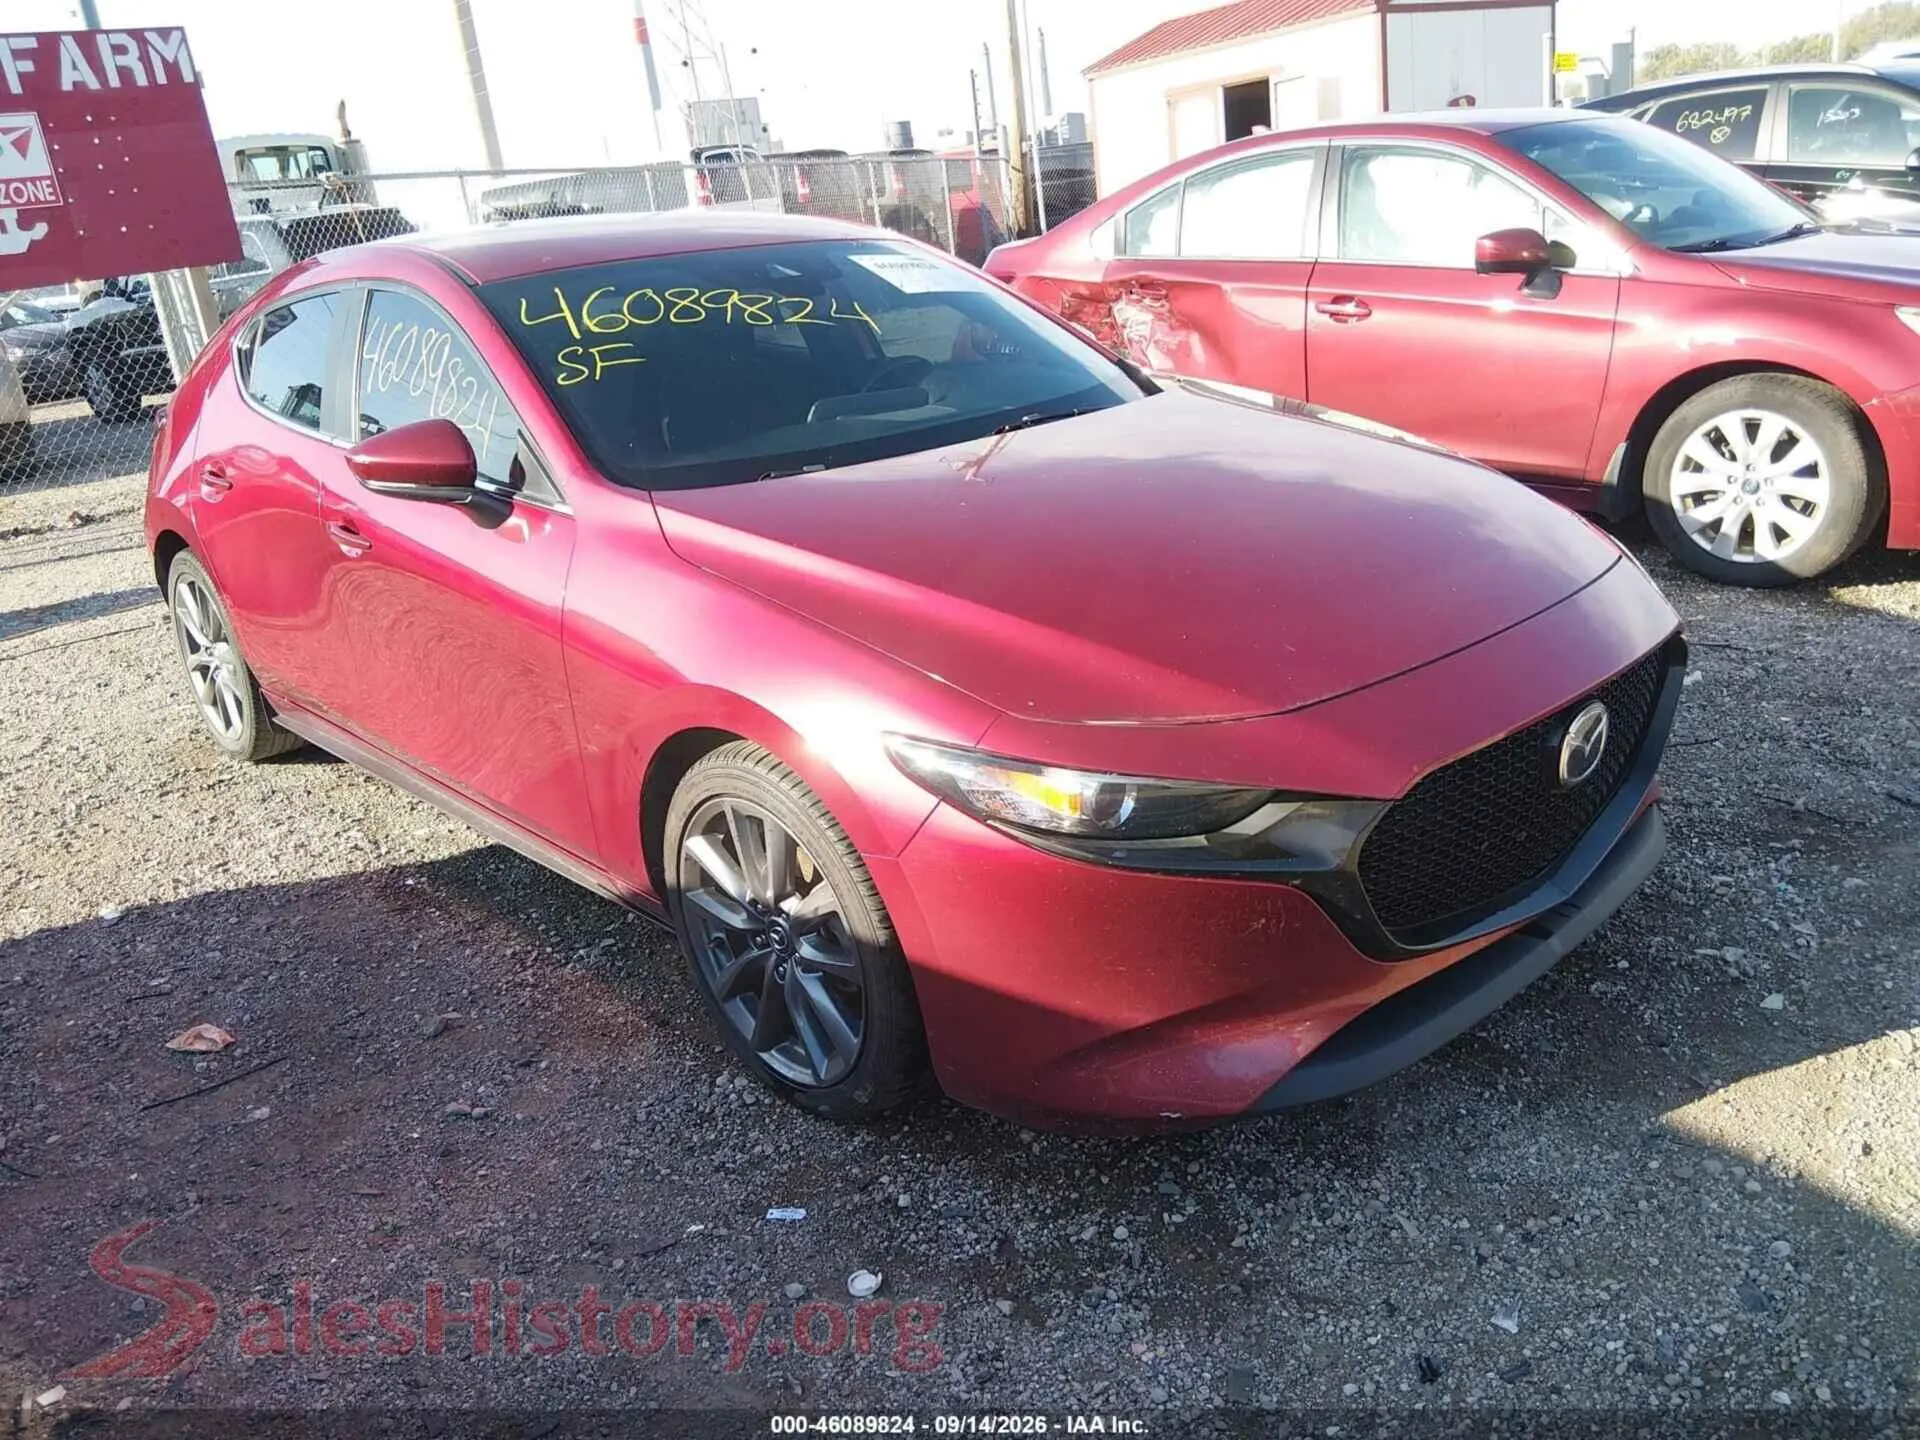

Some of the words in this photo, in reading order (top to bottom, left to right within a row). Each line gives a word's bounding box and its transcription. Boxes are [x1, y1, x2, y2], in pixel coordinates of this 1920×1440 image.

[0, 30, 195, 95] FARM
[519, 286, 882, 340] 46089824
[363, 315, 498, 460] 46089824
[556, 342, 647, 385] SF
